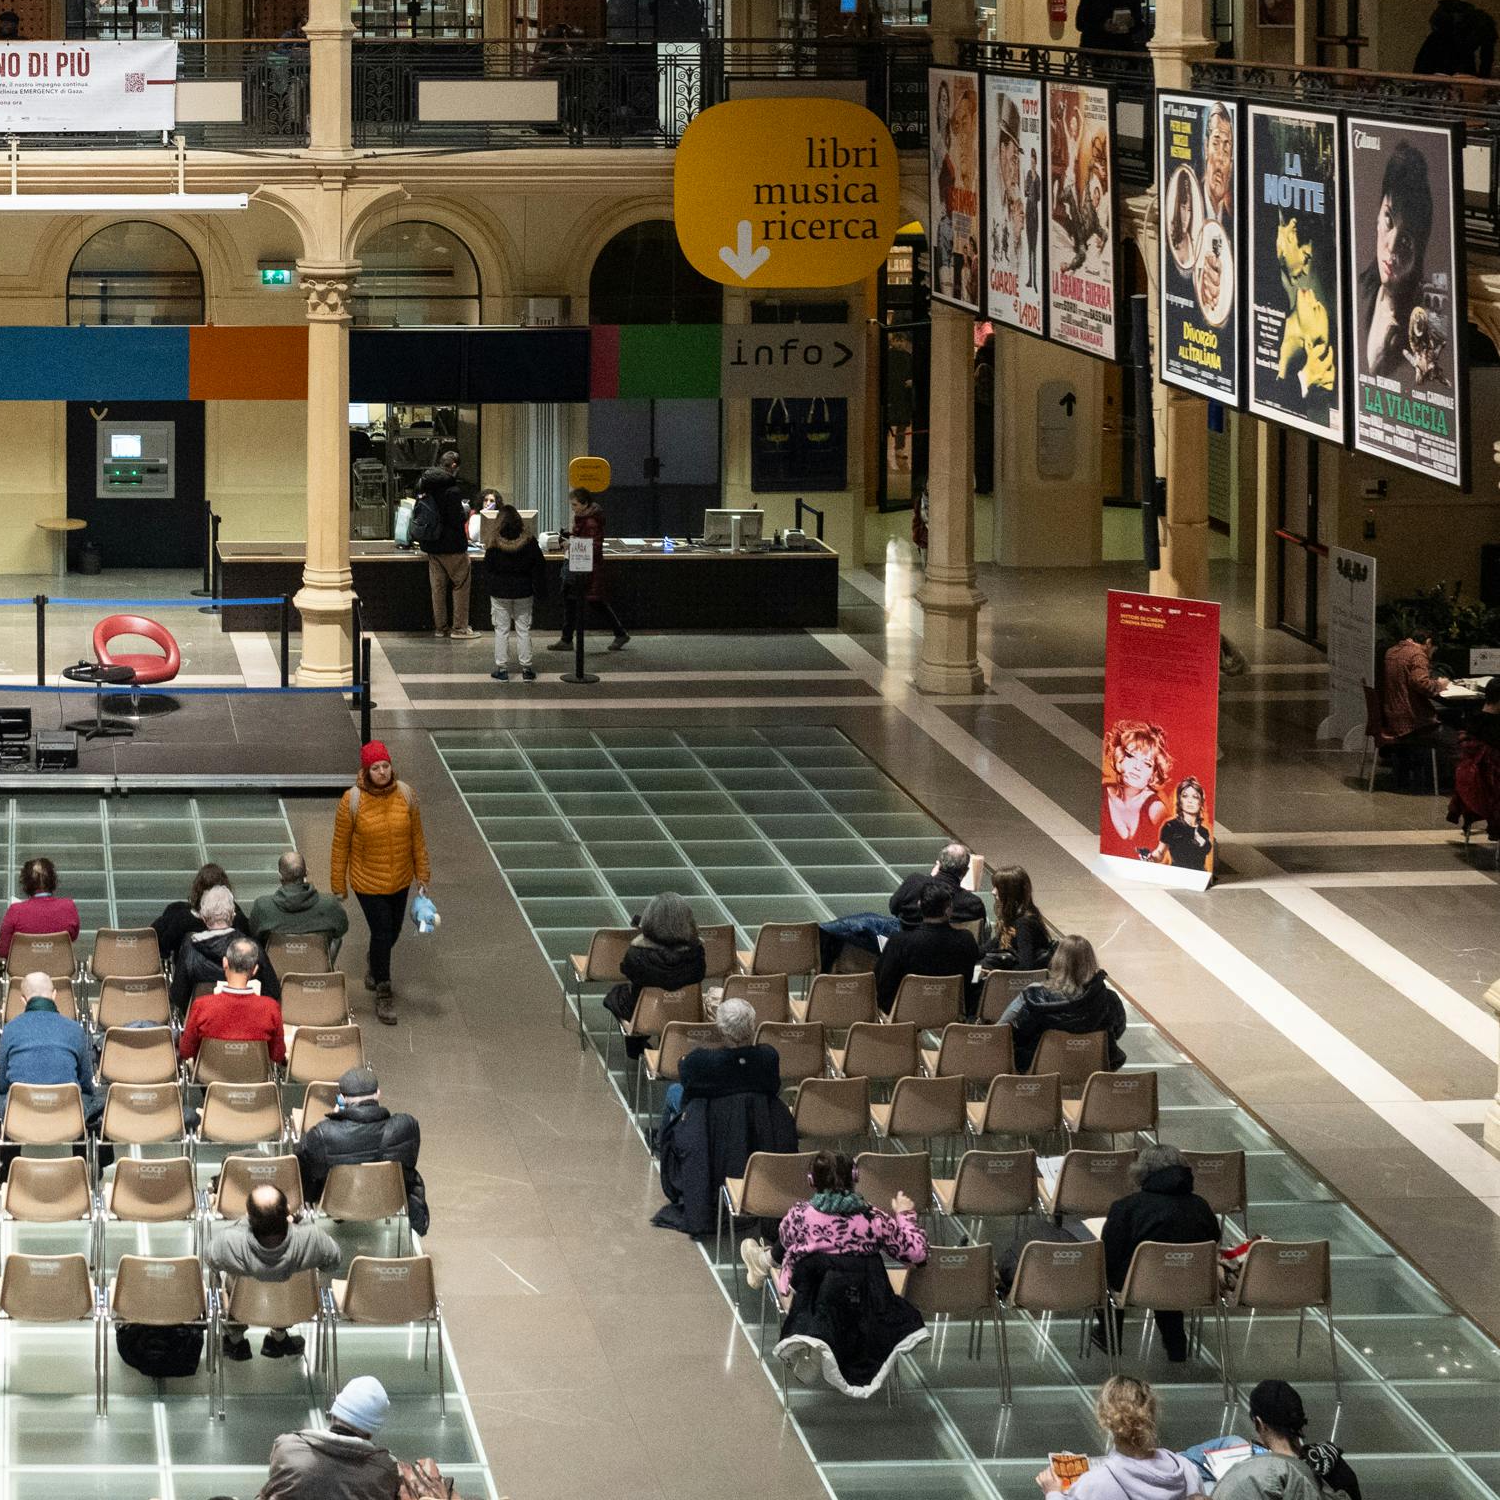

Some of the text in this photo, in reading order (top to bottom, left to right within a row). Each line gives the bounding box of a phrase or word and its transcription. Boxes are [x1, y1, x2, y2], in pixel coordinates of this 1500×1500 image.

[28, 52, 48, 77] DI
[56, 47, 90, 77] PIÙ
[805, 136, 879, 169] libri
[1284, 151, 1303, 178] LA
[753, 175, 879, 205] musica
[1263, 173, 1326, 215] NOTTE
[762, 212, 879, 241] ricerca
[990, 268, 1020, 298] GUARDIE
[1052, 269, 1112, 312] LA GRANDE GUERRA
[1018, 301, 1041, 332] LADRI
[1365, 387, 1383, 415] LA
[1385, 392, 1448, 436] VIACCIA
